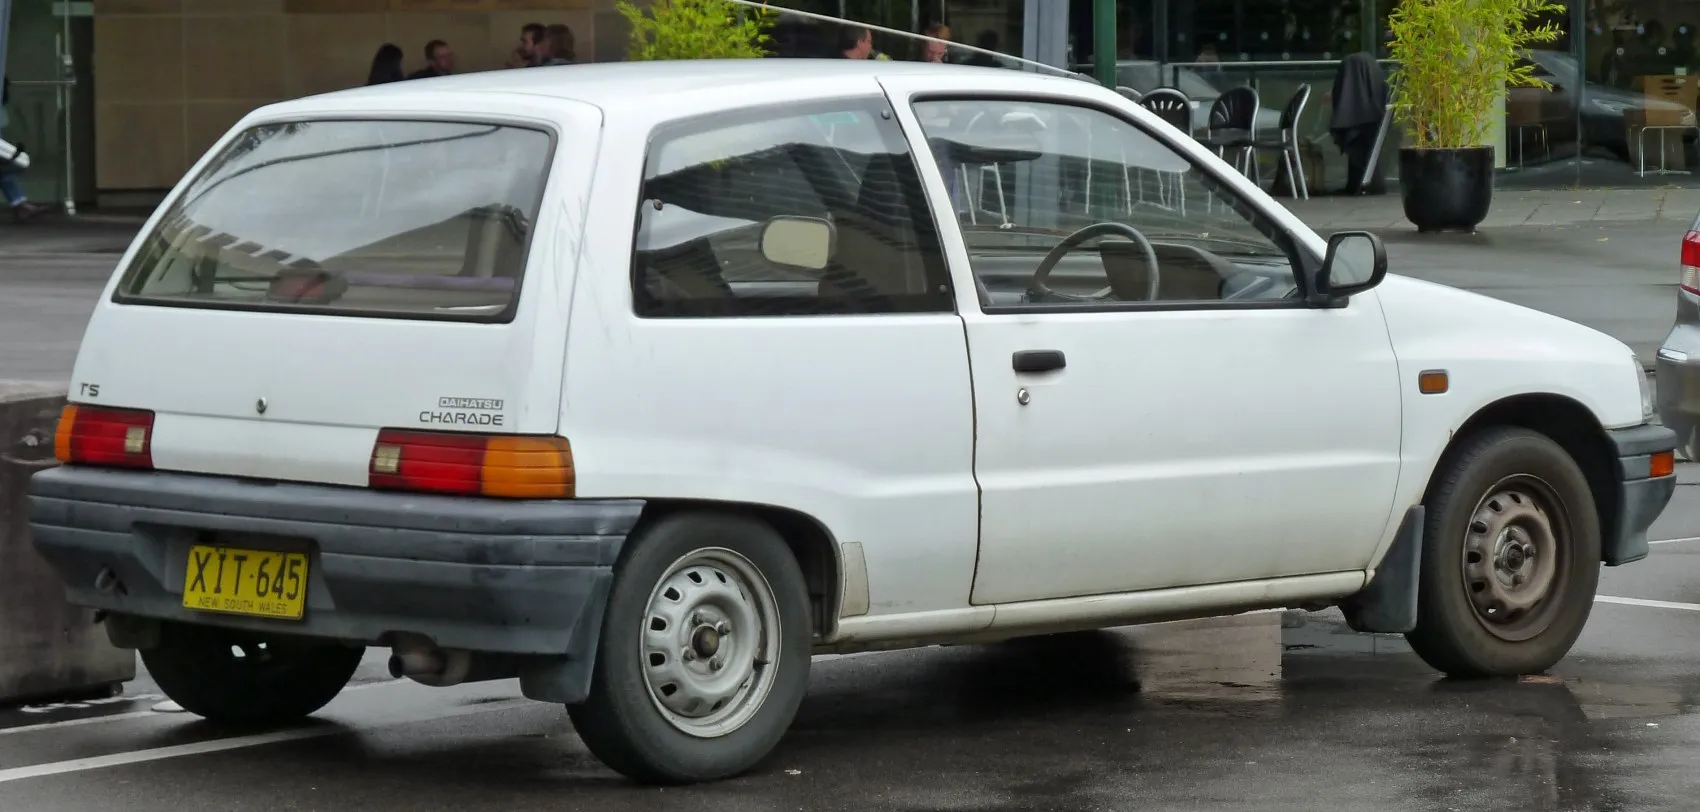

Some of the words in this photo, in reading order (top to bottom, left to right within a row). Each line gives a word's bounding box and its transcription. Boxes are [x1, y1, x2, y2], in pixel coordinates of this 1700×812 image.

[80, 383, 100, 397] TS
[439, 397, 503, 410] DAIHATSU
[419, 411, 504, 426] CHARADE
[199, 597, 218, 608] NEW
[224, 599, 253, 611] SOUTH
[259, 602, 288, 614] WALES
